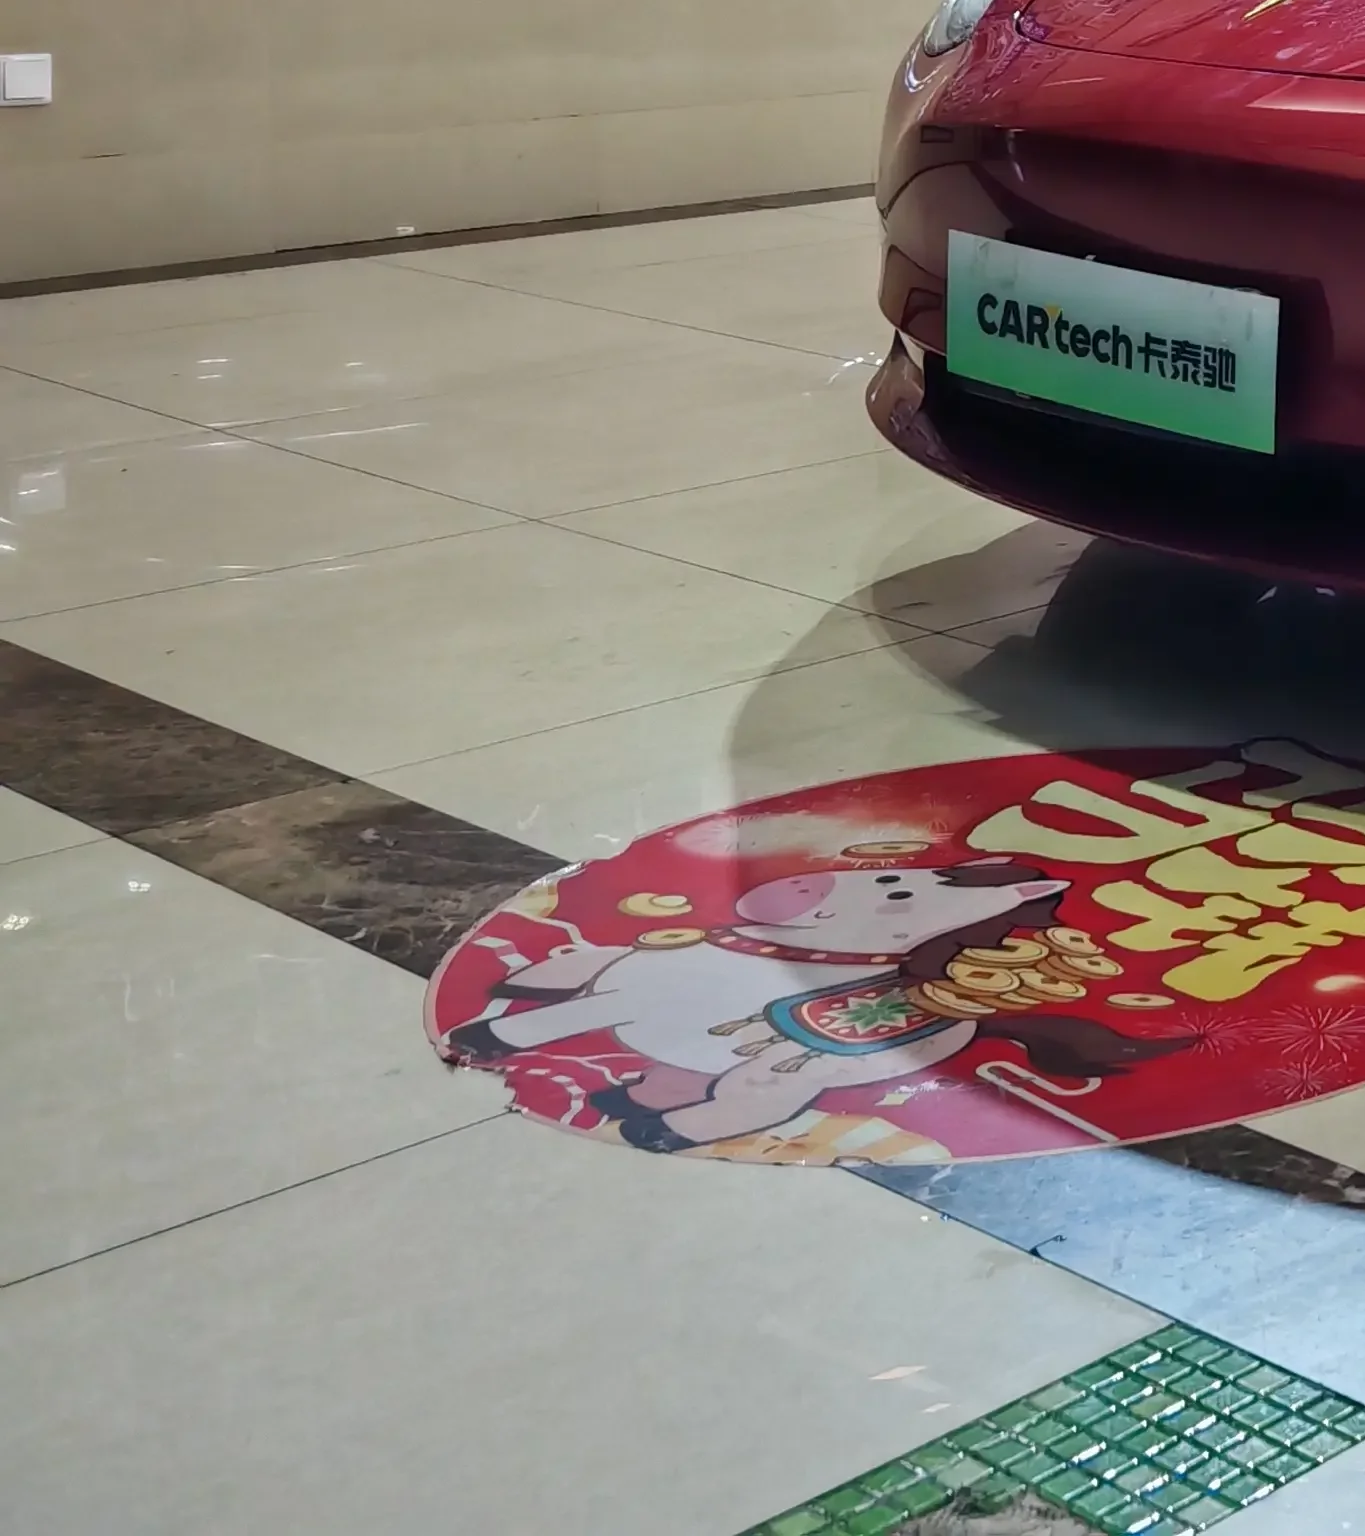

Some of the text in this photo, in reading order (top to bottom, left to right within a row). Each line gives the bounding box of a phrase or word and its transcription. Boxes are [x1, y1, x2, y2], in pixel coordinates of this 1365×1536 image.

[976, 293, 1236, 393] CARtech 卡泰驰
